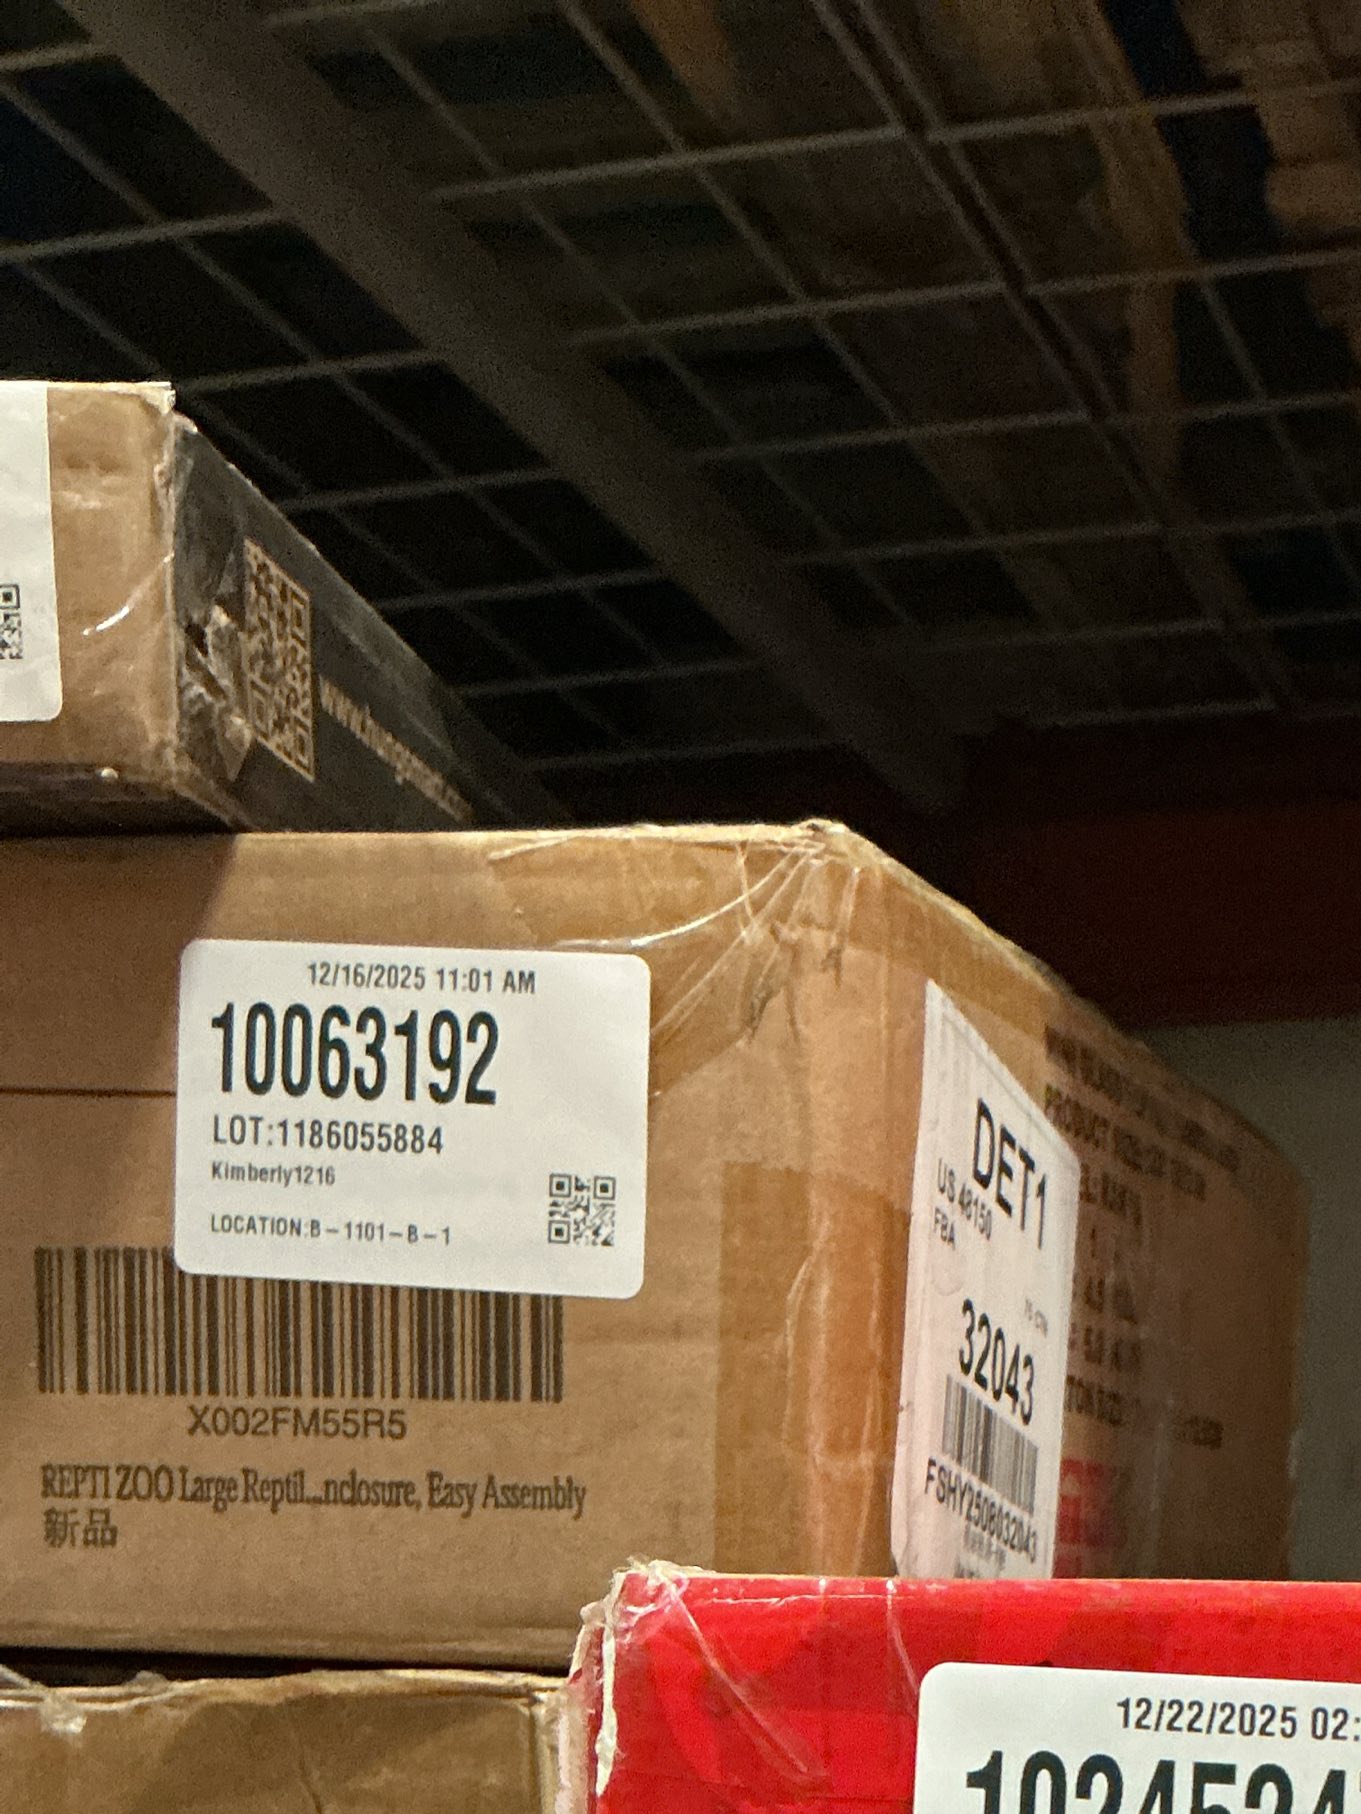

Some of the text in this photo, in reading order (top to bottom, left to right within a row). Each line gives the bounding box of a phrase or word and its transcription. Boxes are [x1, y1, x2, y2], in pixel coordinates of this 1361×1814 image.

[307, 960, 537, 995] 12/16/2025 11:01 AM
[210, 1001, 499, 1106] 10063192
[213, 1113, 444, 1155] LOT:1186055884
[211, 1160, 336, 1188] Kimberly1216
[938, 1157, 956, 1203] US
[973, 1097, 1047, 1250] DET1
[959, 1298, 1034, 1426] 32043
[186, 1403, 408, 1442] X002FM55R5
[40, 1464, 111, 1499] REPTI
[115, 1464, 175, 1501] ZOO
[177, 1465, 238, 1513] Large
[426, 1469, 479, 1519] Easy
[482, 1472, 587, 1521] Assembly
[43, 1507, 118, 1549] 新品
[1116, 1697, 1298, 1739] 12/22/2025
